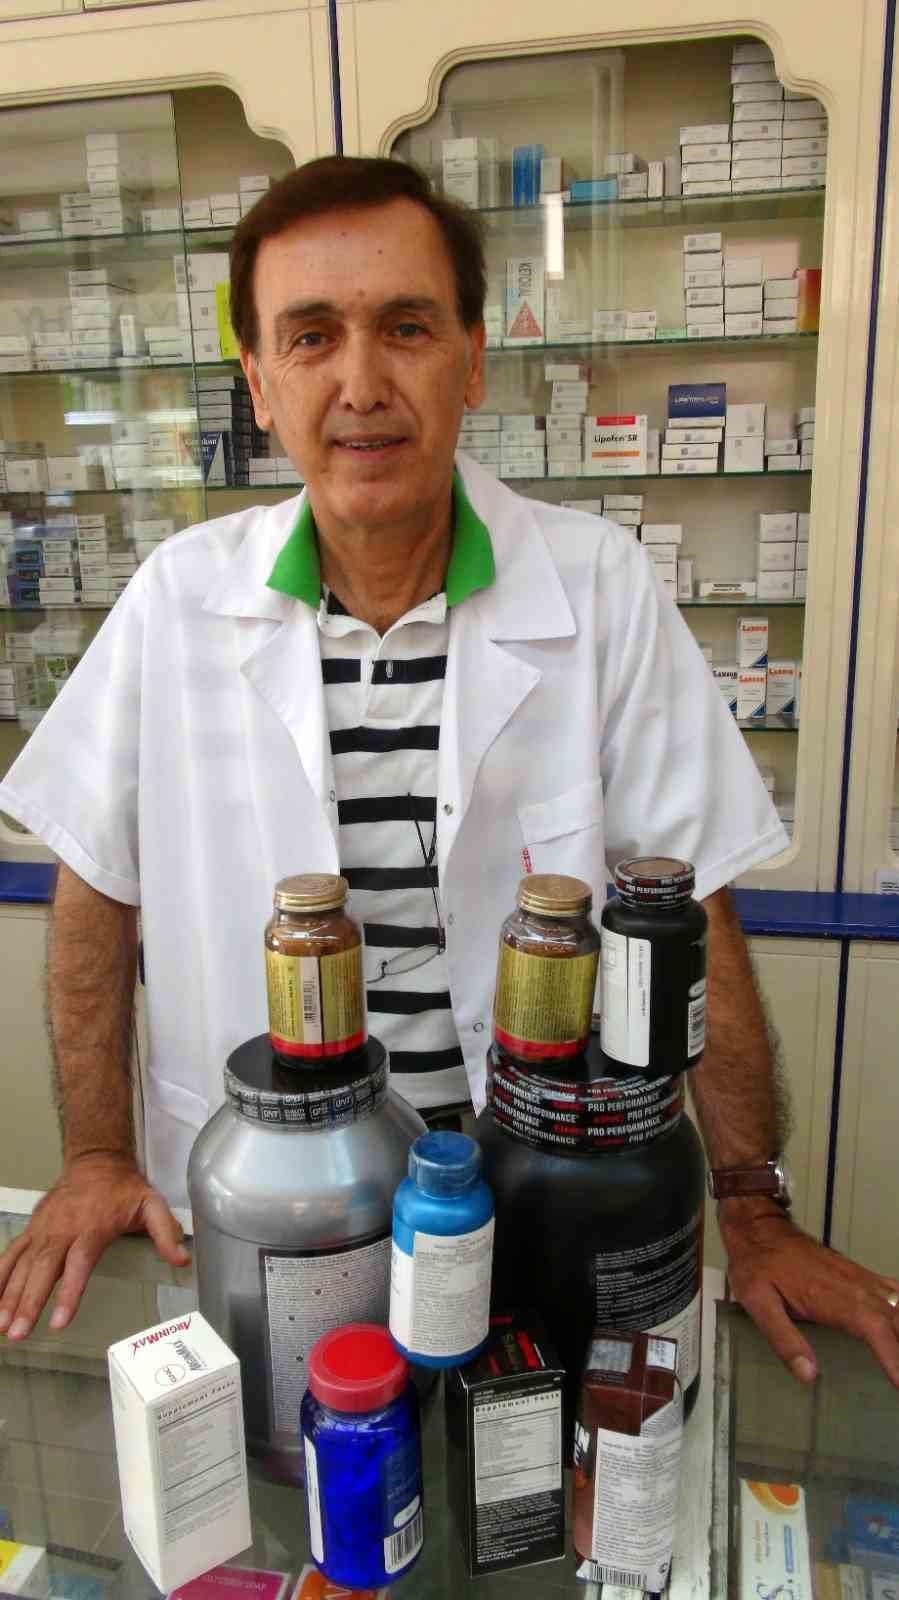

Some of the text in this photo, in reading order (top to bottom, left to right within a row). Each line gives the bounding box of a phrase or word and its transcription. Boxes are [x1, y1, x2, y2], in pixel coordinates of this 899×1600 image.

[587, 1103, 605, 1112] PRO
[607, 1091, 659, 1112] PERFORMANCE
[527, 1103, 577, 1123] PERFORMANCE
[627, 1109, 643, 1121] PRO
[587, 1127, 605, 1137] PRO
[606, 1115, 663, 1137] PERFORMANCE
